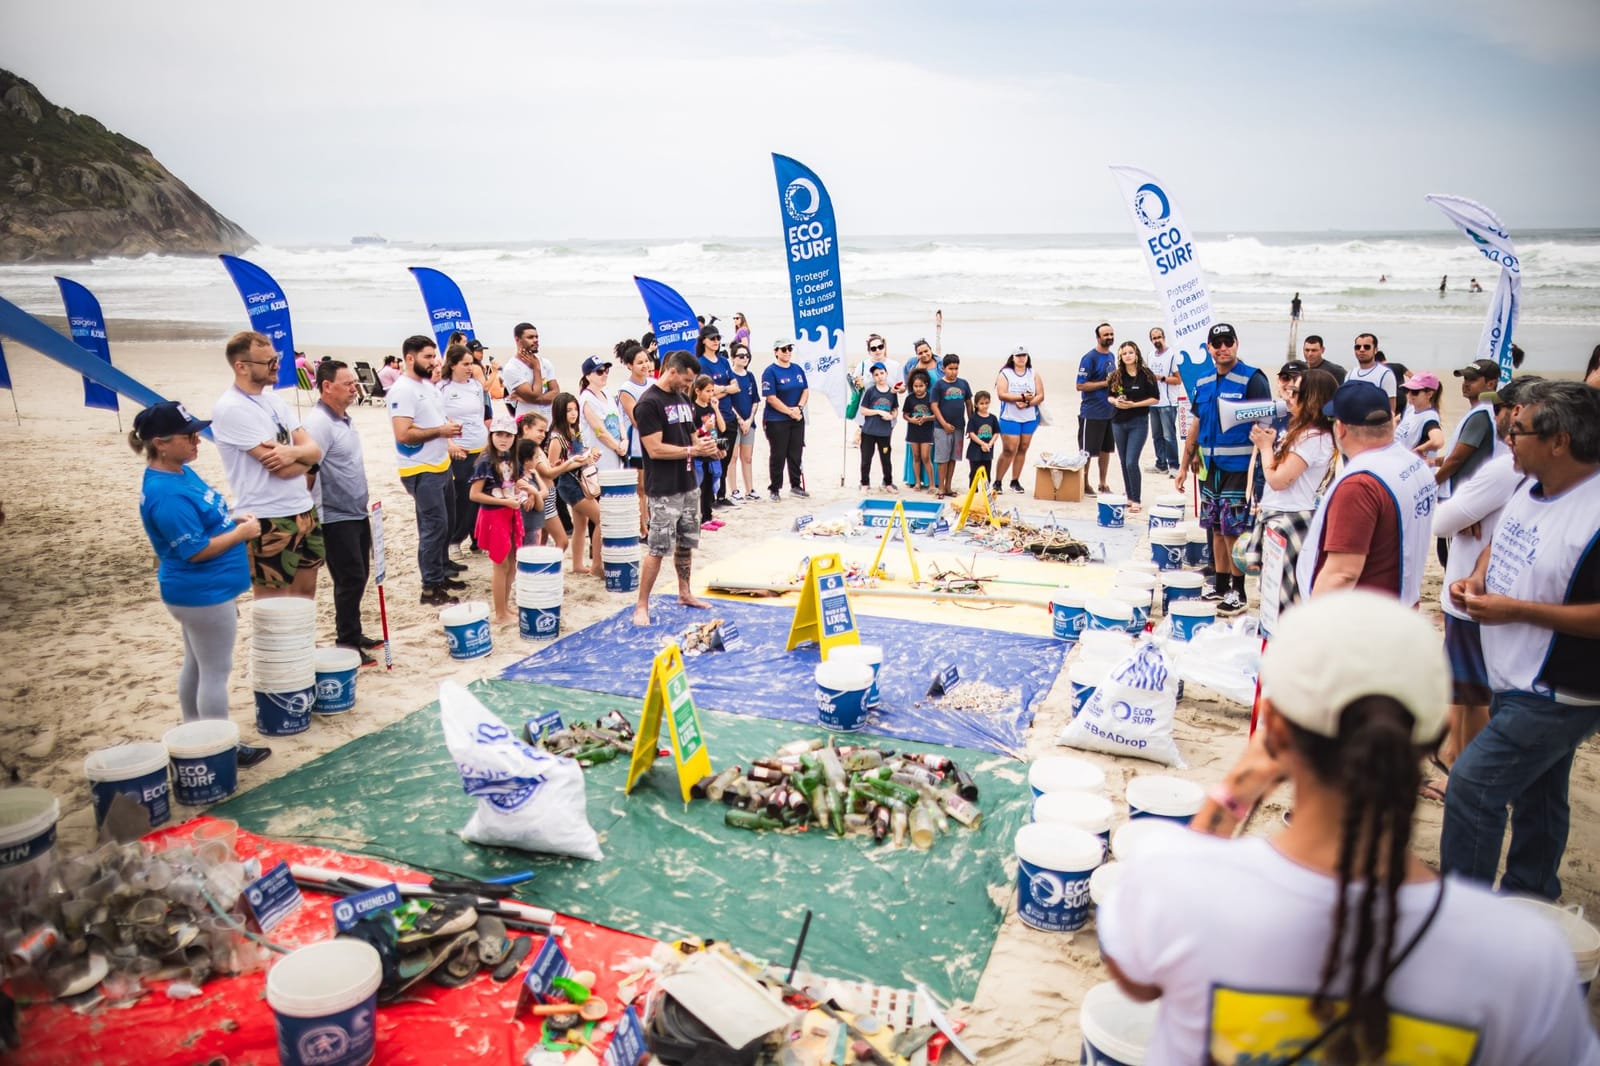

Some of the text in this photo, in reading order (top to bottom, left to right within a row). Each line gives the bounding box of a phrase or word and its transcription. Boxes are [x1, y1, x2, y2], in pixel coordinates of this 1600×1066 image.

[788, 221, 823, 244] ECO
[790, 237, 832, 262] SURF
[1147, 227, 1182, 256] ECO
[1156, 242, 1193, 275] SURF
[795, 268, 830, 283] Proteger
[796, 279, 834, 296] o Oceano
[1166, 277, 1200, 300] Proteger
[804, 294, 816, 306] da
[816, 290, 836, 304] nossa
[799, 302, 834, 319] Natureza
[1170, 304, 1176, 313] o
[681, 329, 699, 342] AZU
[1236, 406, 1275, 420] ecosurf
[1131, 715, 1157, 726] SURF
[1133, 707, 1153, 717] ECO
[1083, 720, 1148, 750] #BeADrop
[178, 765, 208, 777] ECO
[180, 773, 217, 788] SURF
[355, 891, 397, 913] CHINELO
[1063, 893, 1090, 910] SUR
